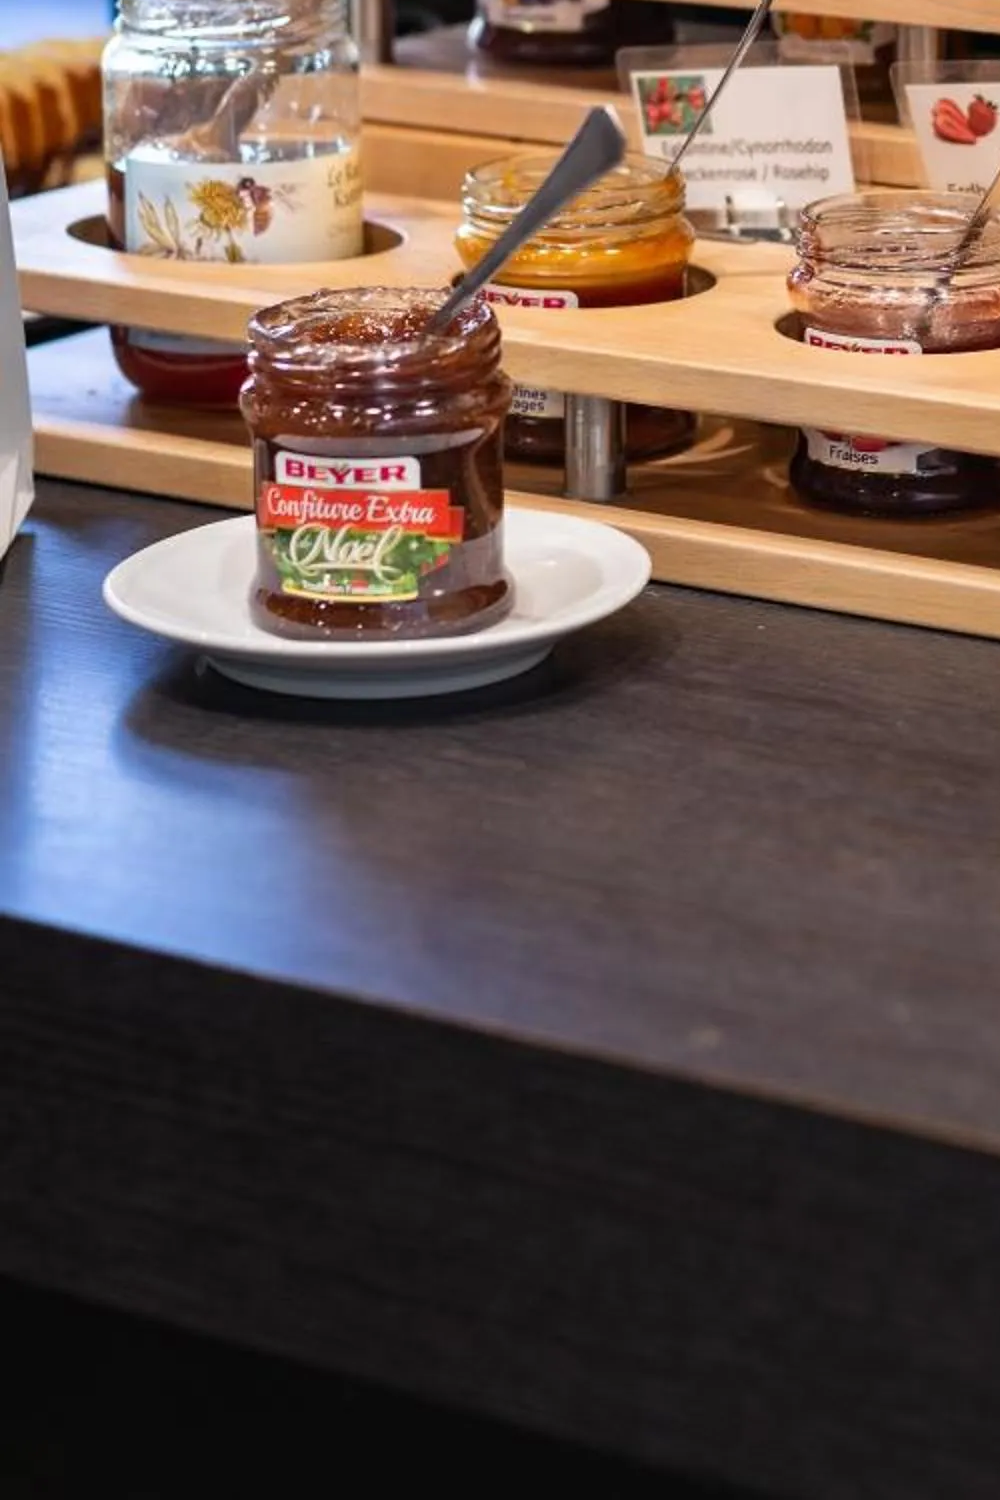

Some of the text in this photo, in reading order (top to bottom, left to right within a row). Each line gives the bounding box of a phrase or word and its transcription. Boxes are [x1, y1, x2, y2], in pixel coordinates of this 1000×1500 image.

[685, 164, 757, 182] eckenrose
[773, 164, 830, 184] Rosehip
[829, 445, 880, 465] Fraises
[285, 458, 406, 484] BEYER
[267, 488, 436, 525] Confiture Extra
[286, 522, 402, 584] Noël
